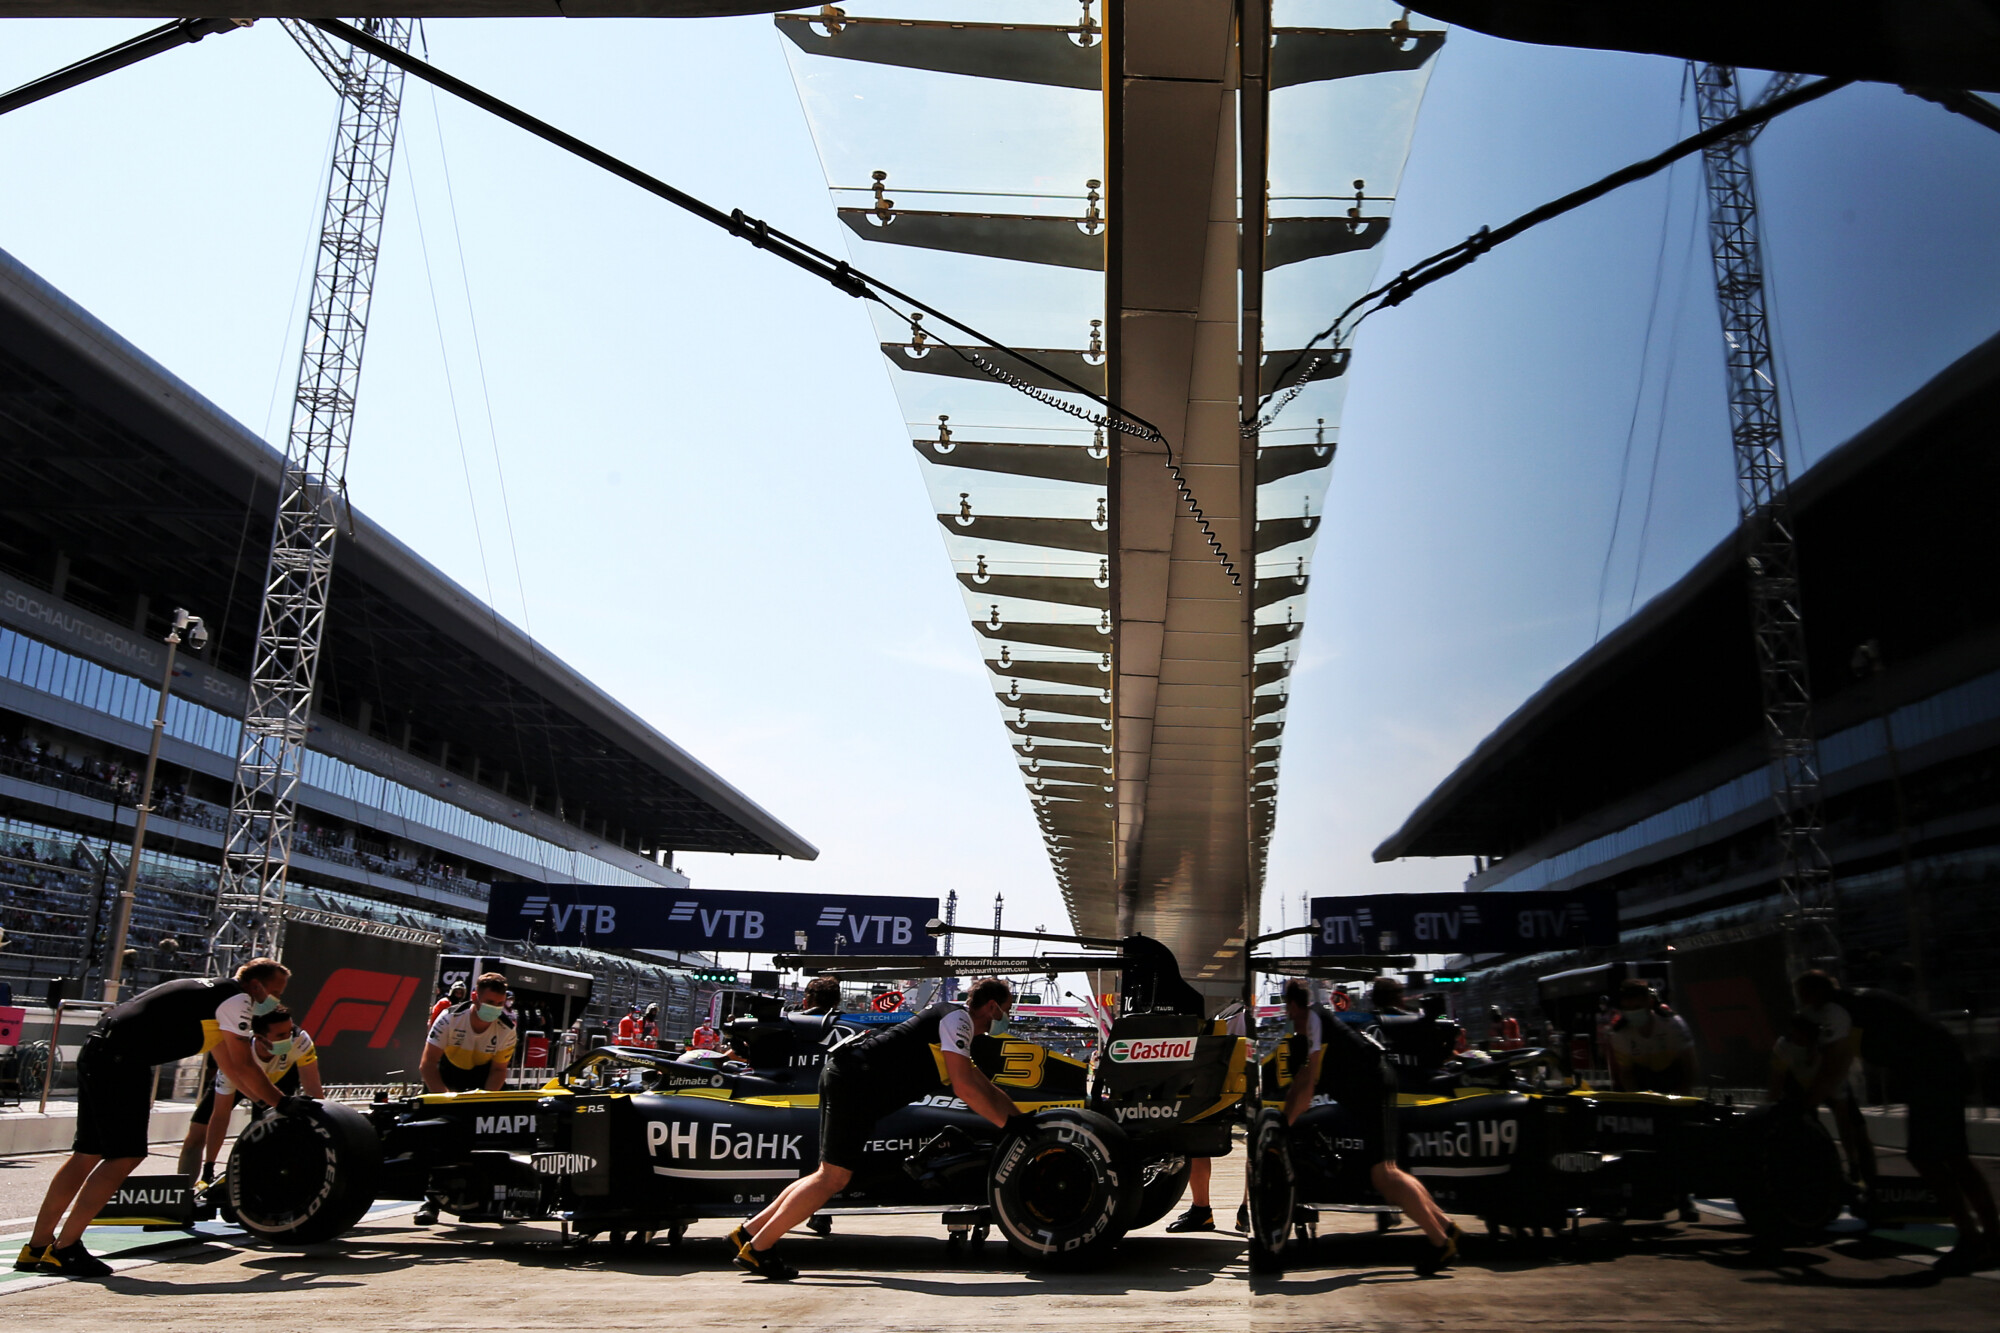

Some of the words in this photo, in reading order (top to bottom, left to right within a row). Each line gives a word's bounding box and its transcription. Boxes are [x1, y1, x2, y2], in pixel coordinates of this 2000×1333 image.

[551, 904, 616, 934] VTB
[700, 909, 764, 939] VTB
[849, 914, 913, 945] VTB
[1130, 1040, 1191, 1059] Castrol
[991, 1041, 1047, 1089] 3
[669, 1075, 708, 1086] ultimate
[1115, 1101, 1182, 1123] yahoo!
[647, 1121, 698, 1159] РН
[710, 1123, 803, 1160] Банк
[863, 1139, 913, 1152] TECH
[540, 1154, 590, 1174] DUPONT
[107, 1189, 185, 1205] ENAULT
